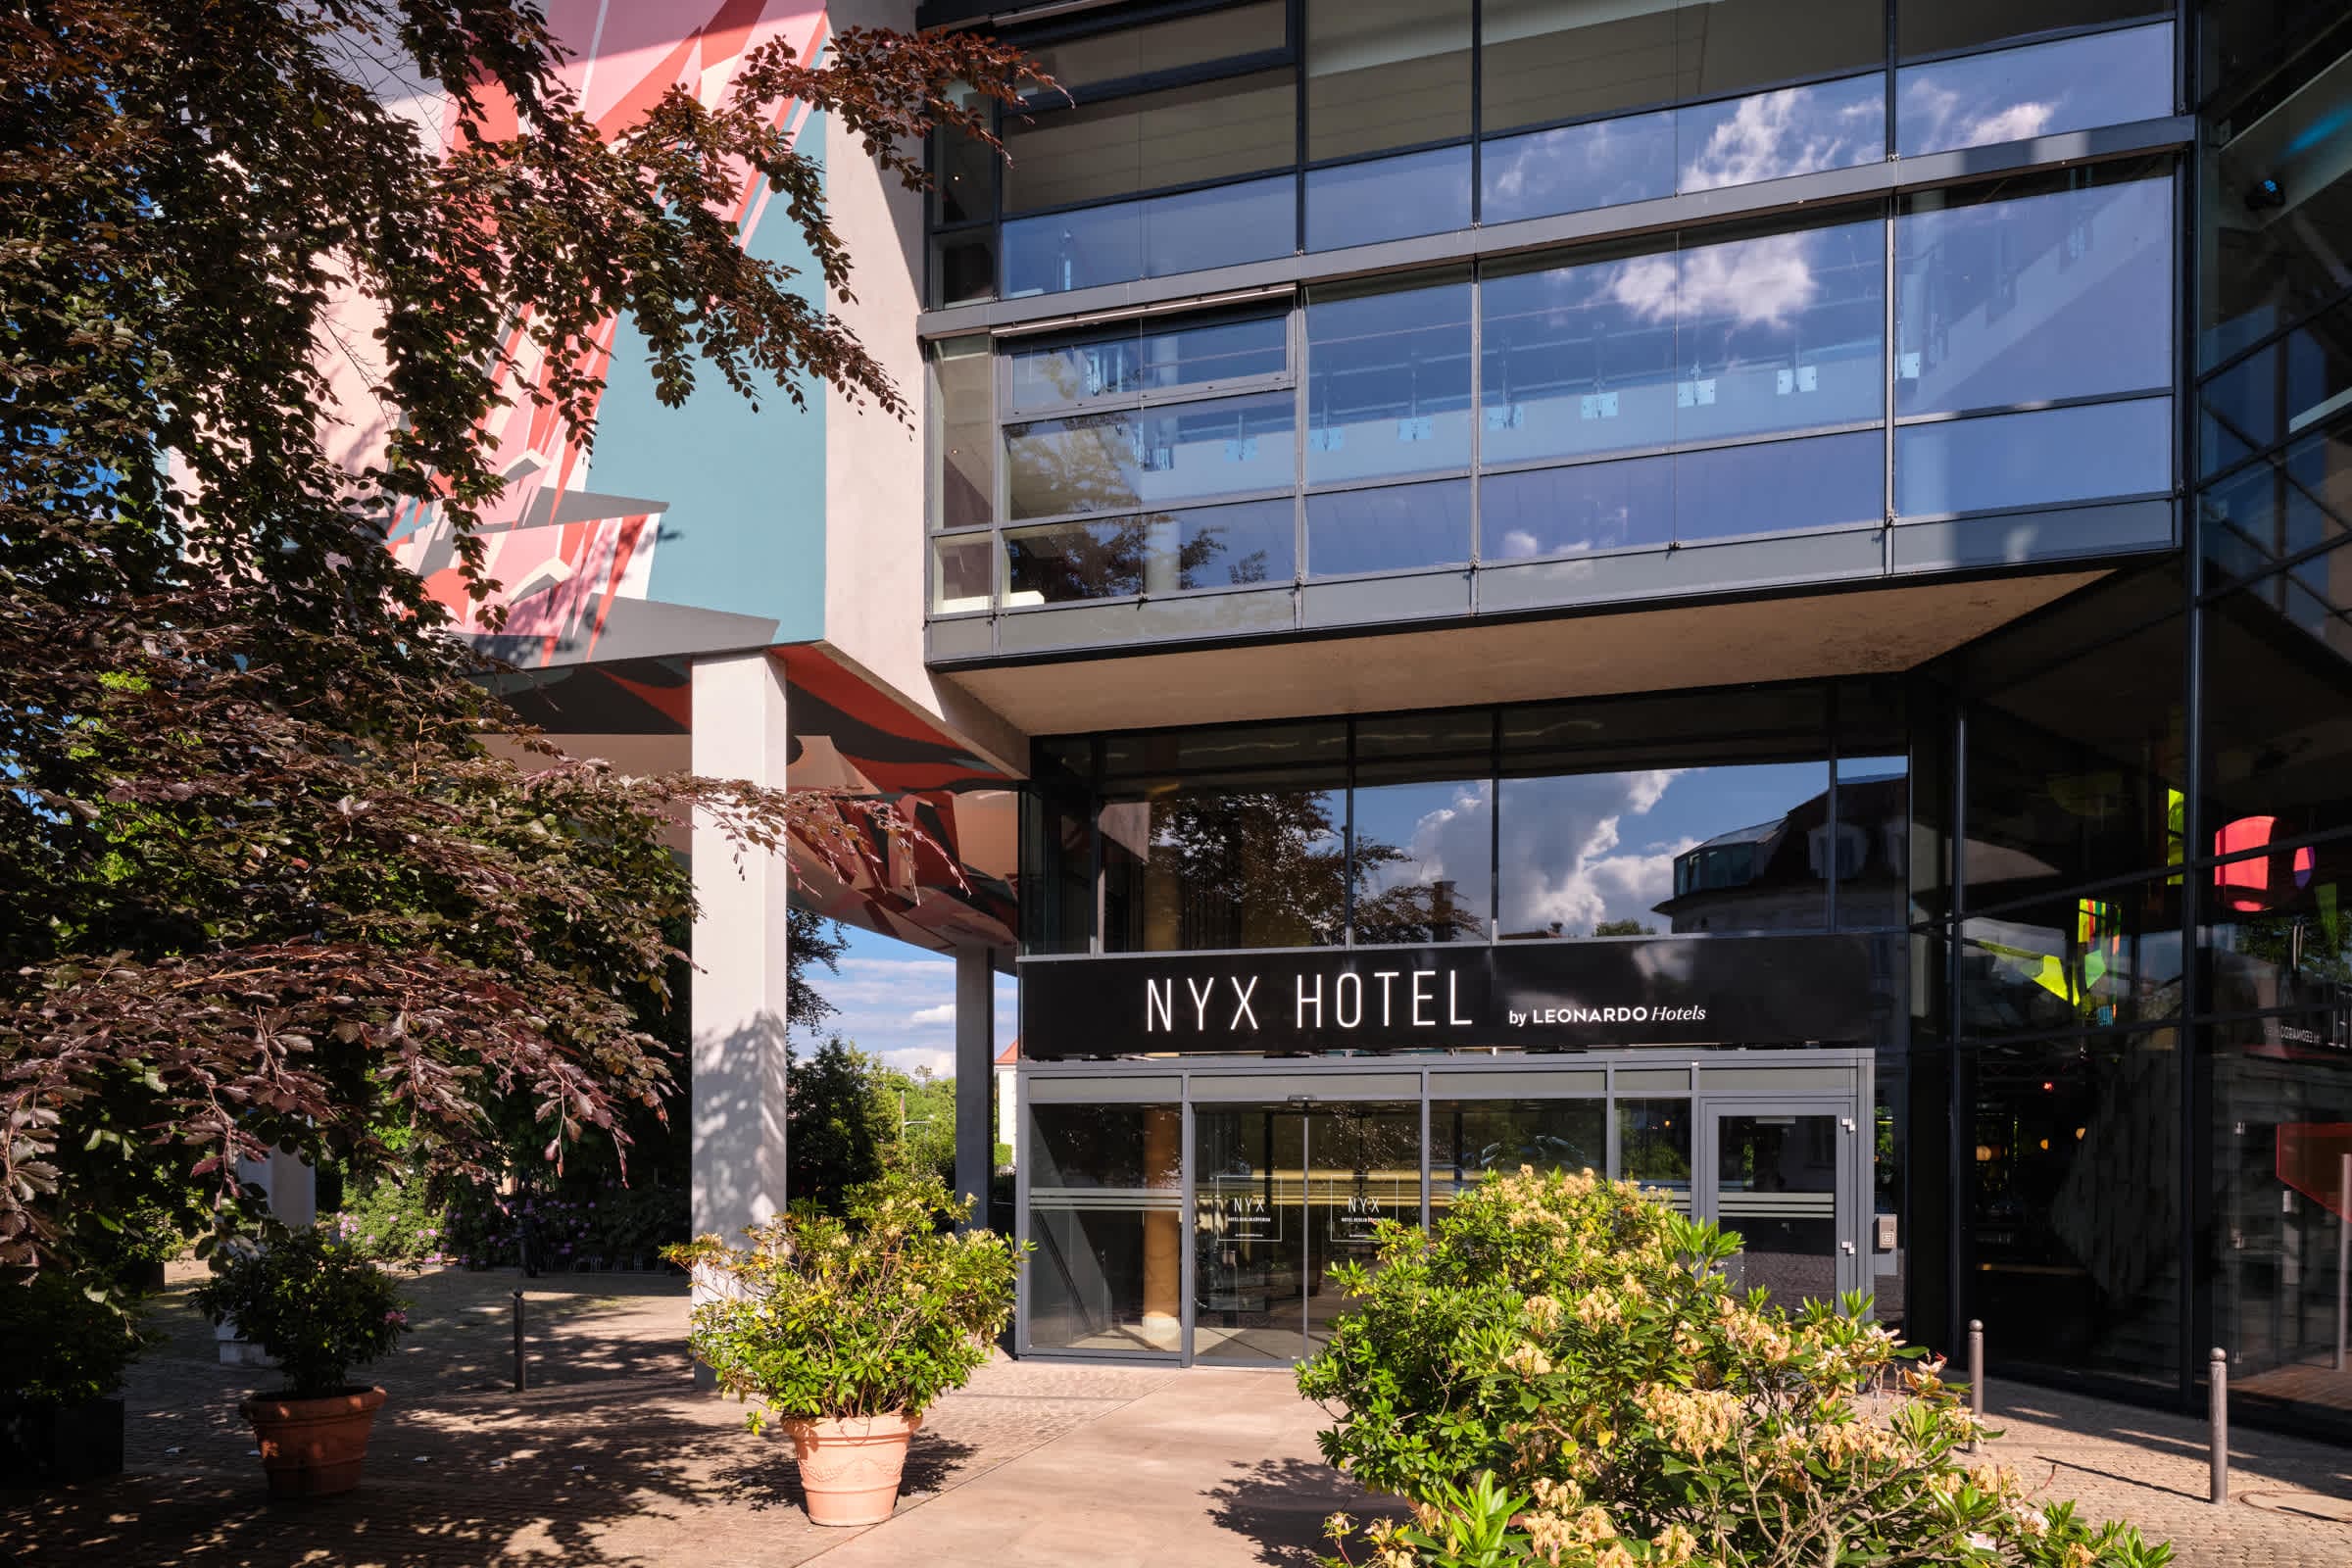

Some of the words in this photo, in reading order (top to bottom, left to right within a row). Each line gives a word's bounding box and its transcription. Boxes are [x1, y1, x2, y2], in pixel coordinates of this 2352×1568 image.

[1148, 975, 1258, 1032] NYX
[1296, 969, 1473, 1029] HOTEL
[1508, 1009, 1527, 1027] by
[1533, 1006, 1648, 1024] LEONARDO
[1650, 1004, 1706, 1021] Hotels
[1234, 1197, 1264, 1213] NYX
[1348, 1196, 1380, 1214] NYX
